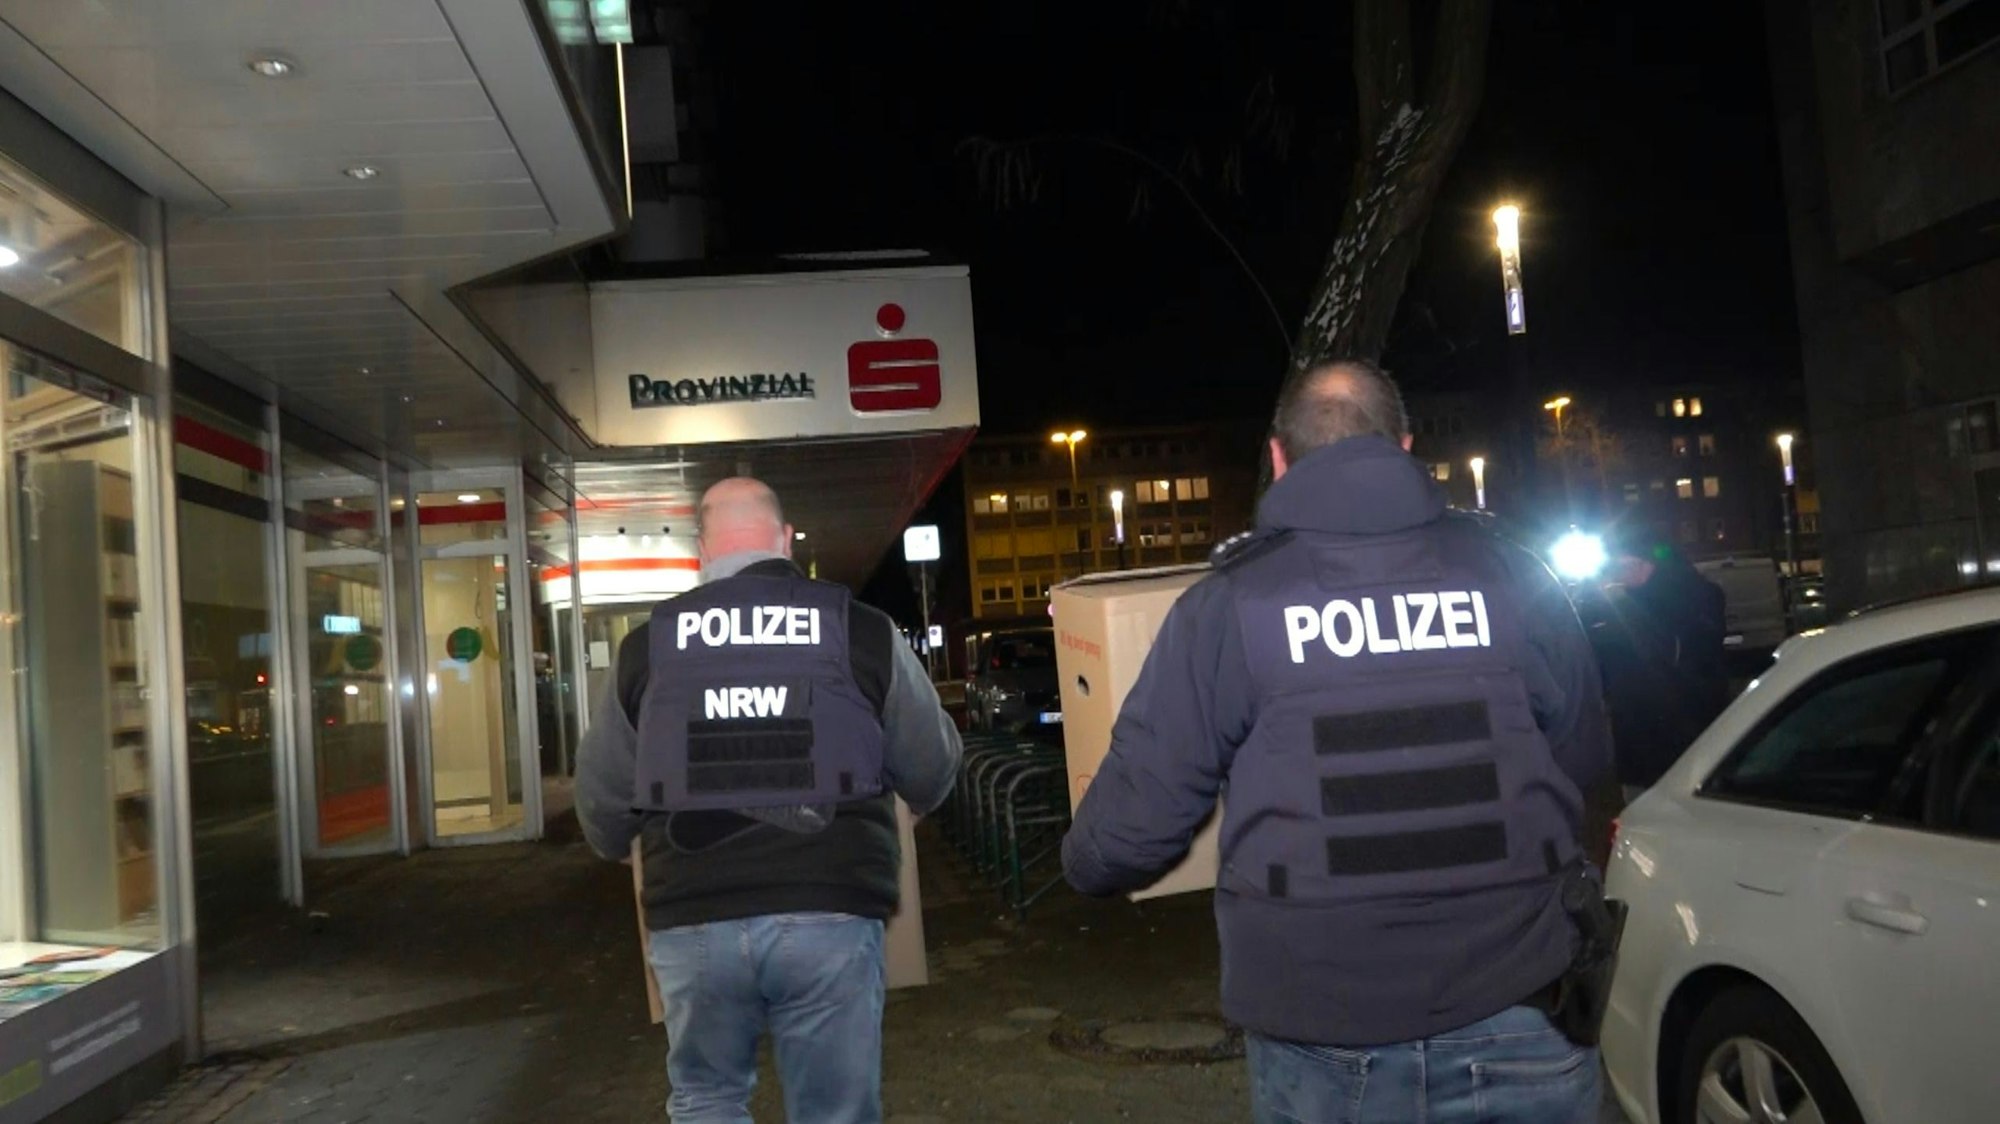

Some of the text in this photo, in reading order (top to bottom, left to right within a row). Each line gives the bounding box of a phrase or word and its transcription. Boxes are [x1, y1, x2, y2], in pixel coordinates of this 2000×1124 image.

[628, 372, 815, 407] PROVINZIAL
[677, 606, 820, 650] POLIZEI
[1284, 591, 1490, 663] POLIZEI
[704, 686, 788, 719] NRW
